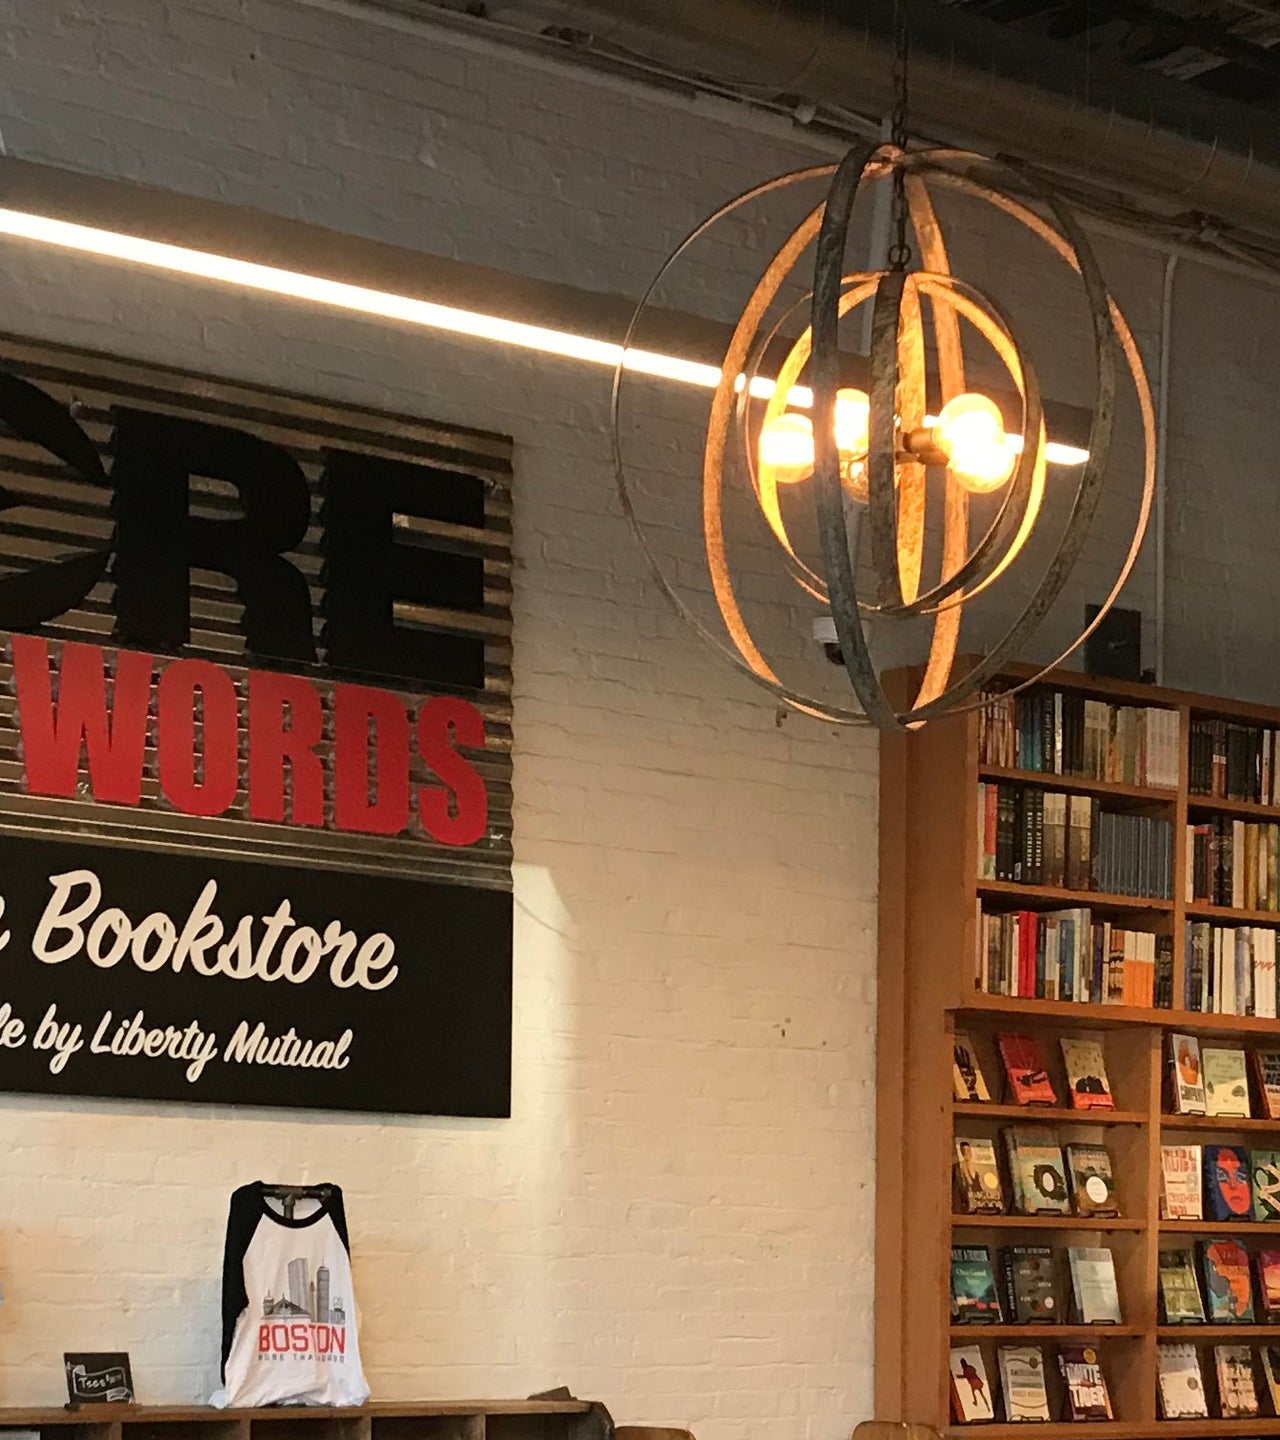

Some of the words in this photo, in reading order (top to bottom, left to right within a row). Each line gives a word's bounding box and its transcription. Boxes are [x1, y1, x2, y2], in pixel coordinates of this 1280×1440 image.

[8, 633, 488, 847] WORDS
[31, 868, 399, 990] Bookstore
[32, 1003, 83, 1074] by
[89, 1010, 218, 1082] Liberty
[223, 1021, 353, 1071] Mutual
[258, 1323, 346, 1354] BOSTON
